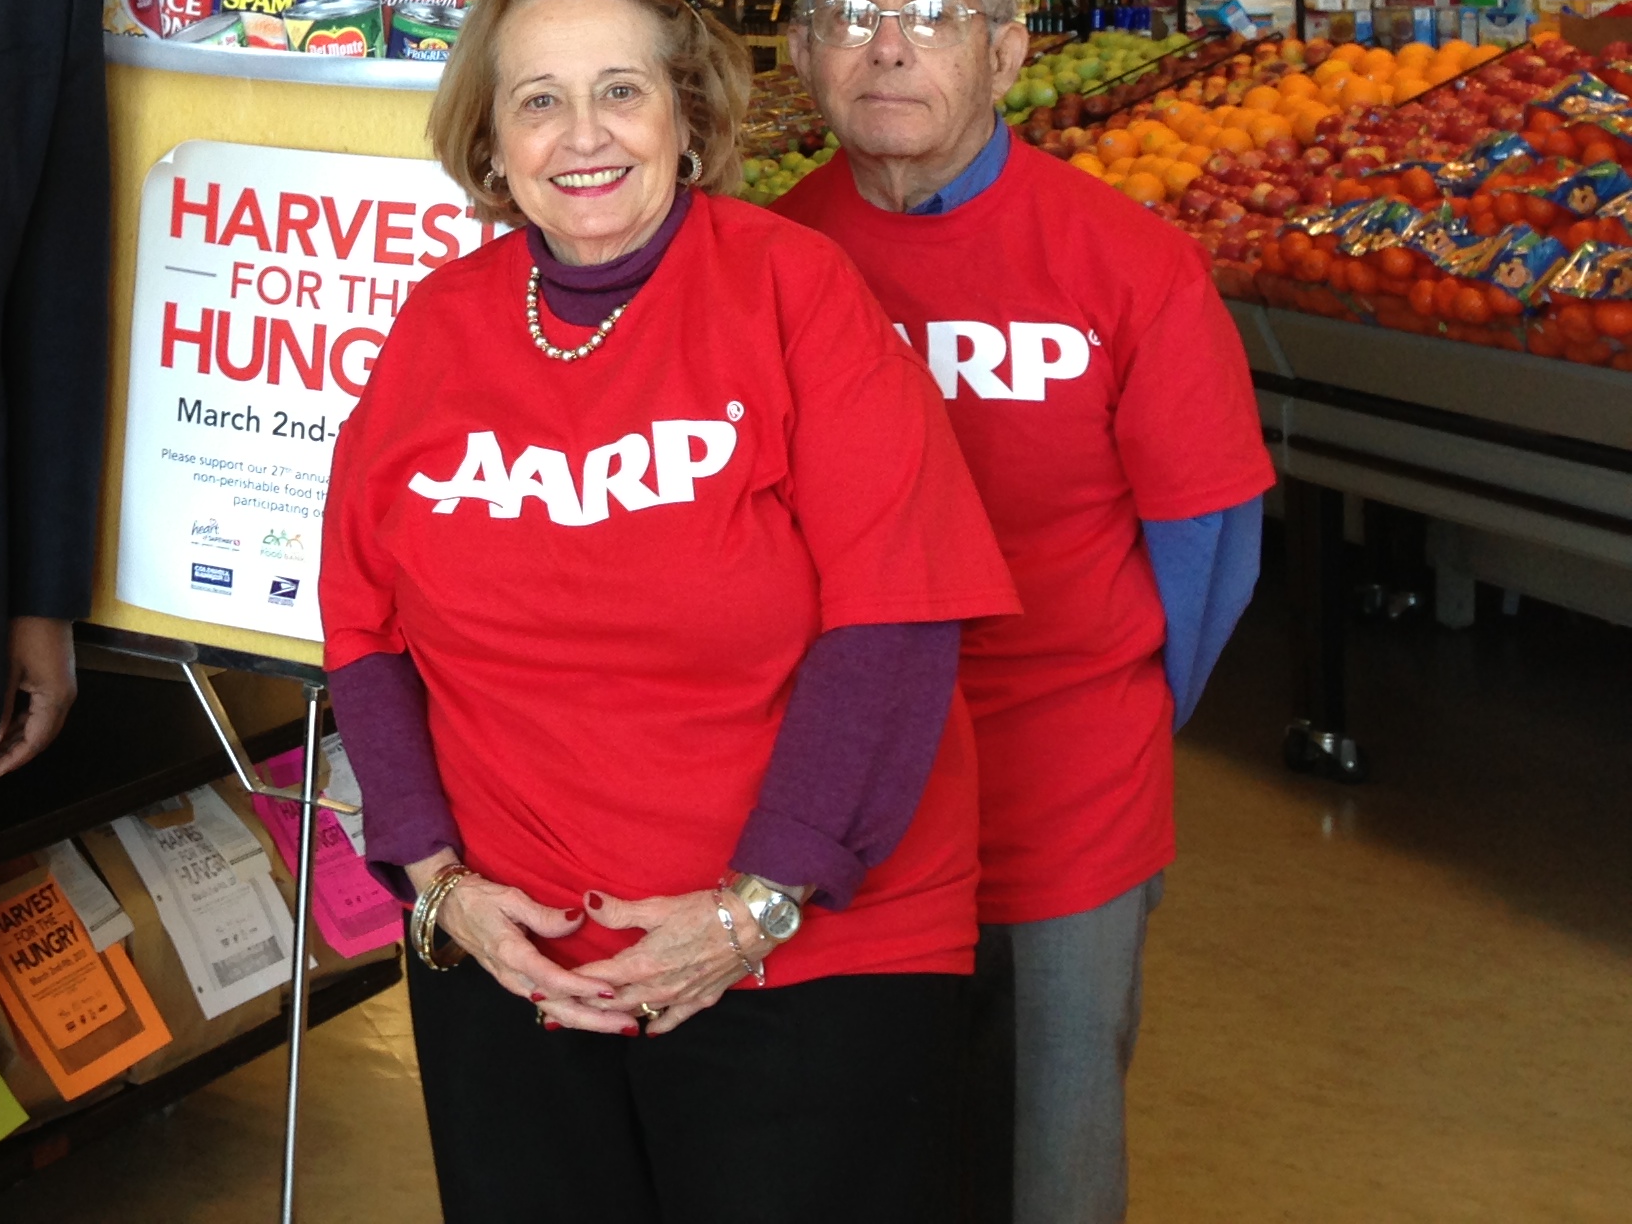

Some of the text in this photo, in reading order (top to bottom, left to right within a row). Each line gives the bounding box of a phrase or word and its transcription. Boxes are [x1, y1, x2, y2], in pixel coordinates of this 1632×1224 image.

[325, 40, 364, 57] Monte
[230, 261, 323, 310] FOR
[893, 320, 1090, 402] RP
[177, 396, 261, 434] March
[161, 448, 196, 464] Please
[199, 456, 244, 473] support
[247, 464, 268, 475] our
[407, 419, 738, 527] AARP
[193, 472, 280, 495] non-perishable
[284, 483, 313, 500] food
[233, 496, 310, 519] participating
[13, 912, 59, 945] FOR THE
[9, 919, 79, 974] HUNGRY
